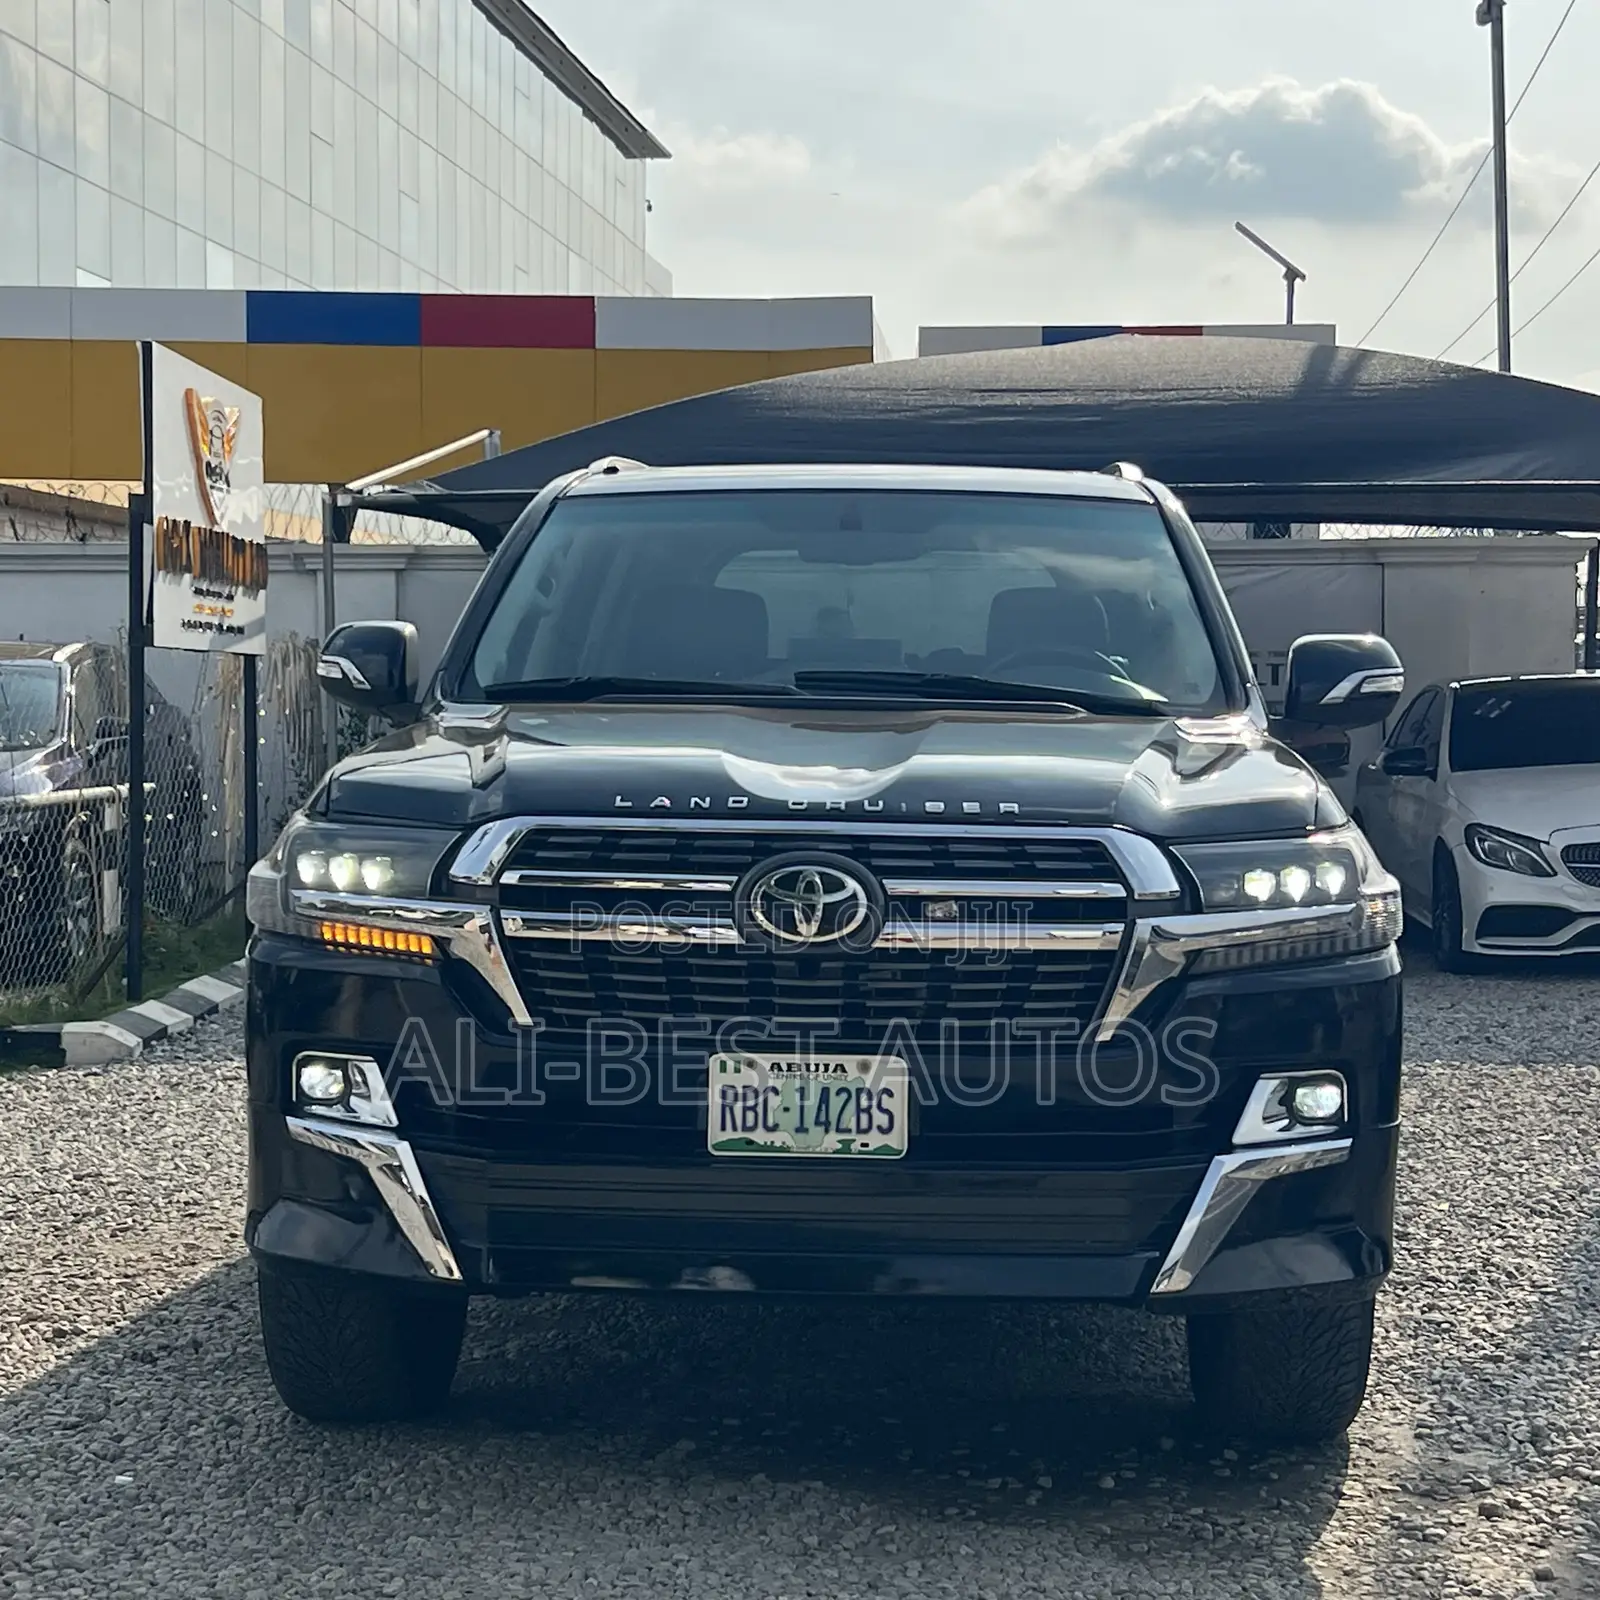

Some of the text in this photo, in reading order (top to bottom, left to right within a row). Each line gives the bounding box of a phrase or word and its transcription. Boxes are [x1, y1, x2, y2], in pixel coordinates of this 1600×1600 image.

[613, 794, 1020, 815] LAND CRUISER
[768, 1061, 848, 1074] ABUJA
[719, 1084, 895, 1136] RBC-142BS
